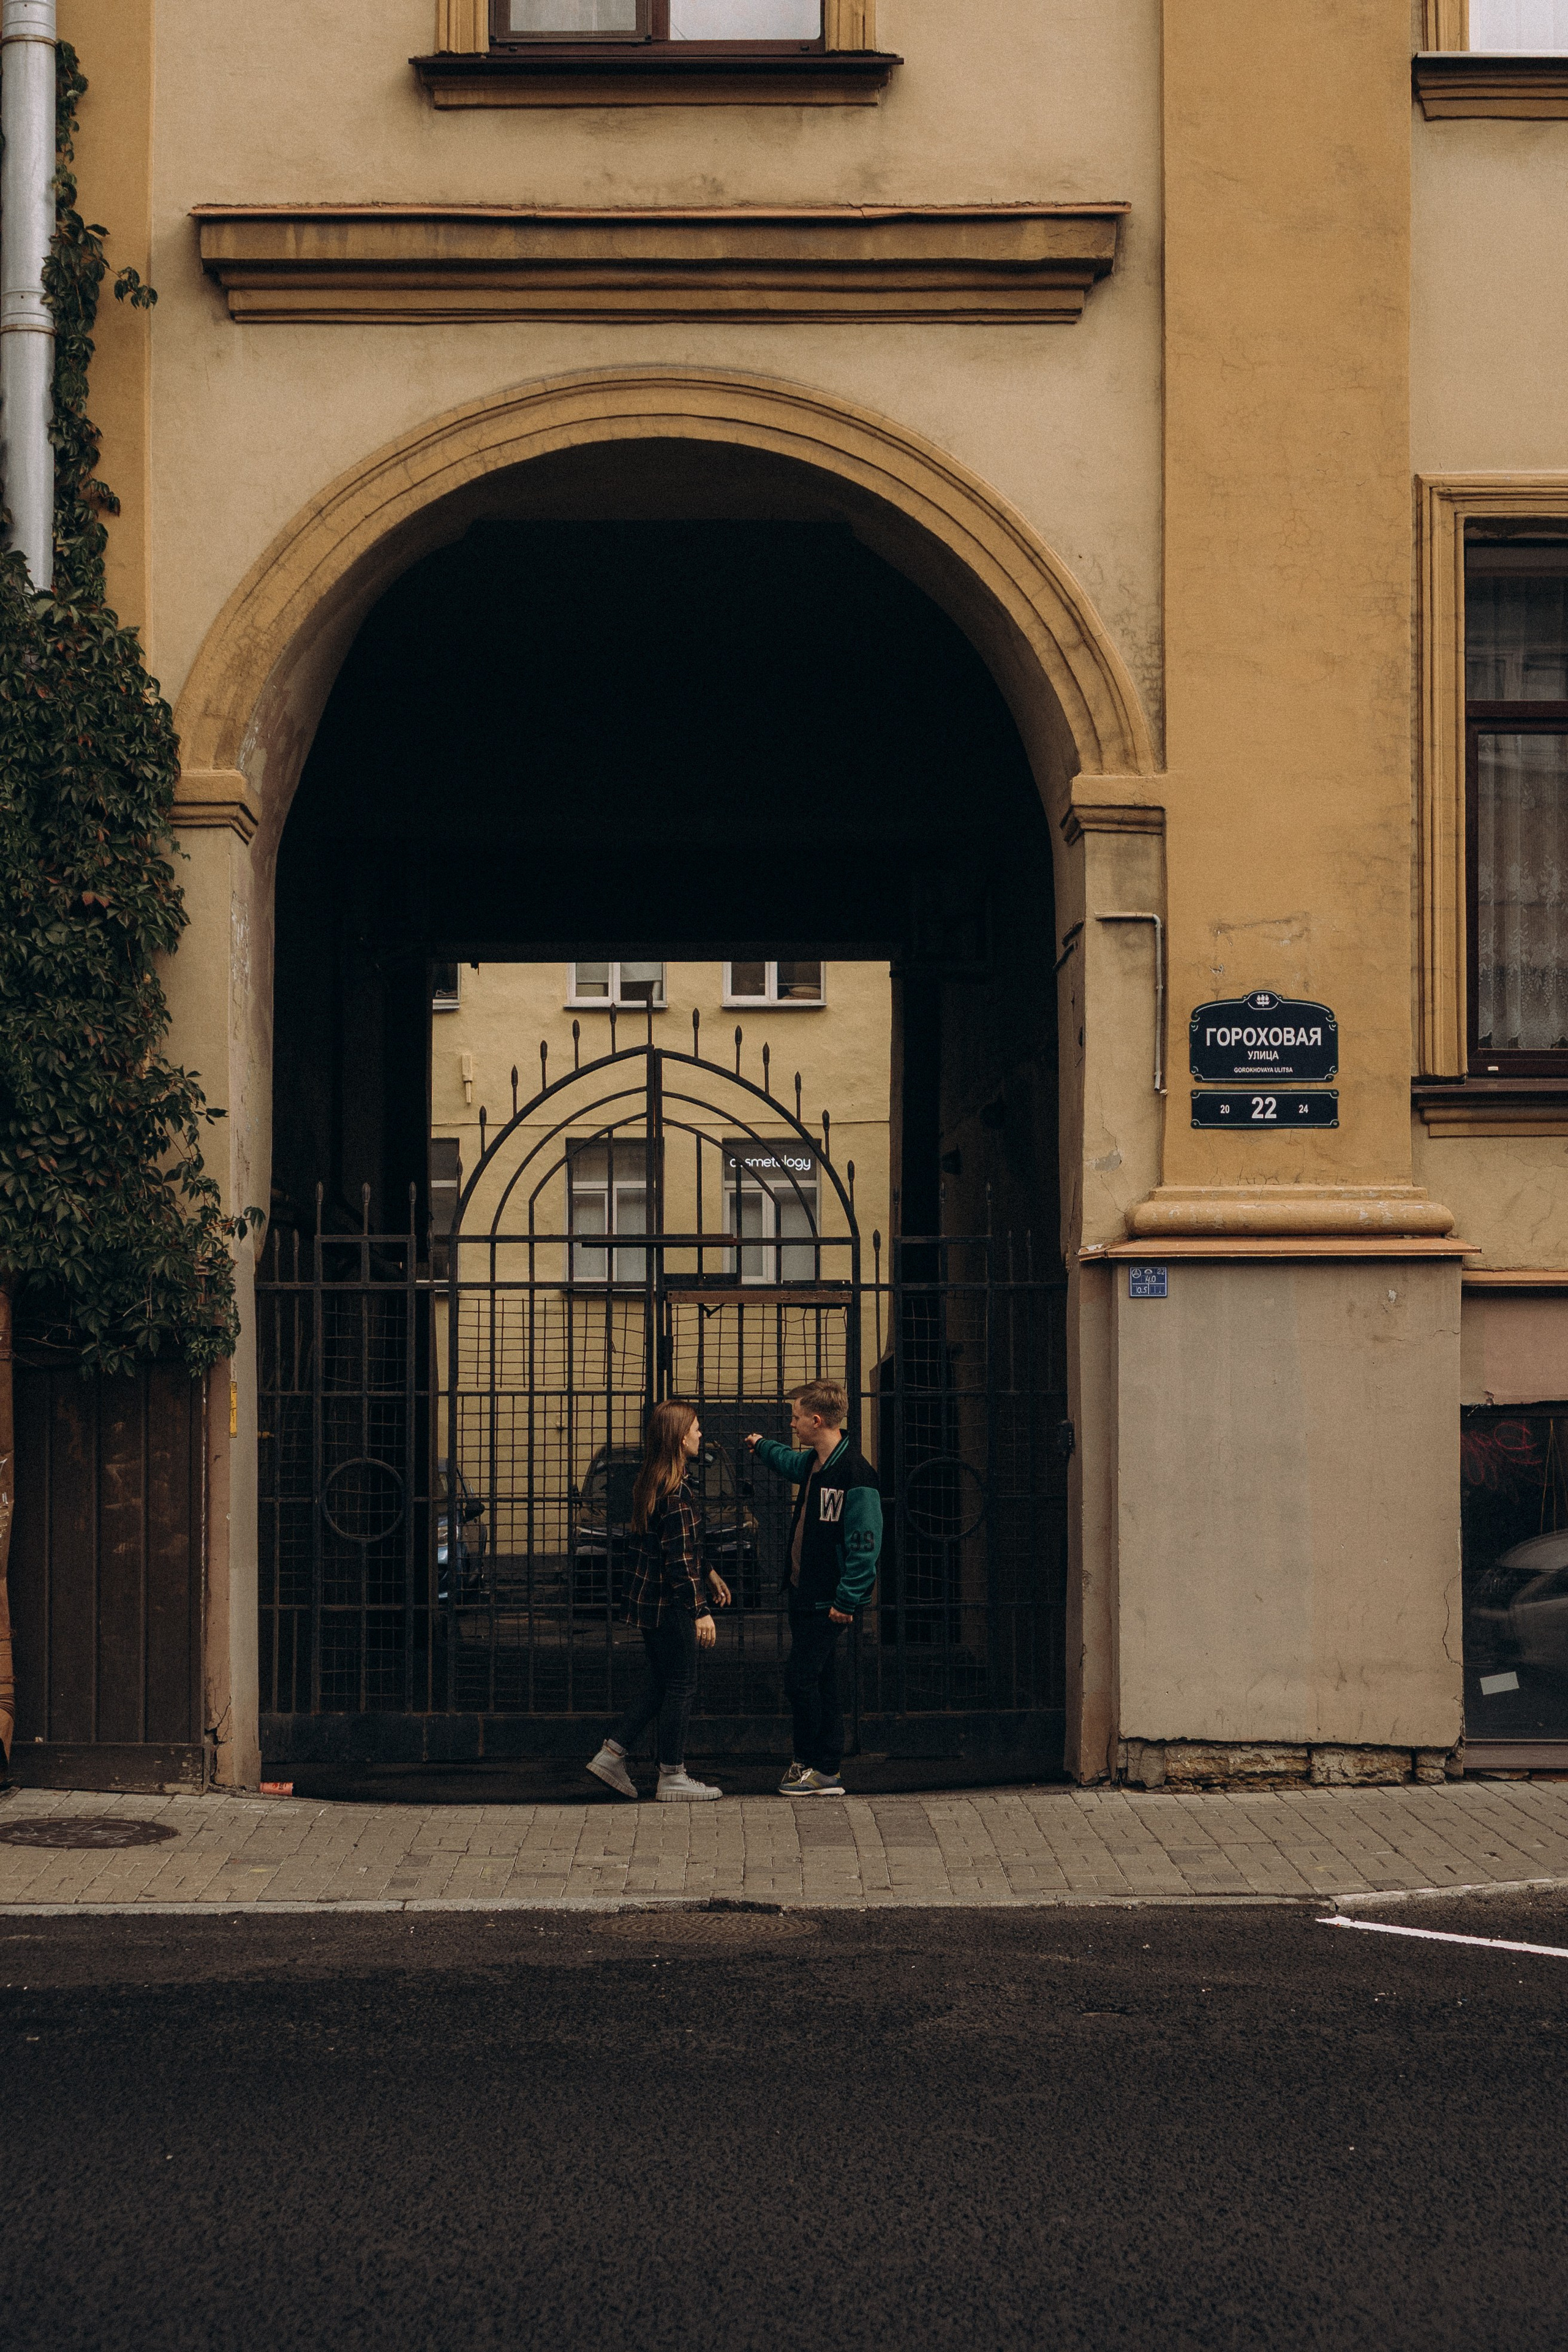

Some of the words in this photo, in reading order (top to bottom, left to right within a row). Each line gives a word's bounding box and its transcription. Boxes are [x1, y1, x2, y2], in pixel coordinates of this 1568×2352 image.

[1205, 1027, 1322, 1046] ГОРОХОВАЯ
[1247, 1050, 1279, 1061] УЛИЦА
[1220, 1104, 1230, 1114] 20
[1251, 1096, 1277, 1119] 22
[1298, 1104, 1308, 1114] 24
[729, 1155, 811, 1171] csmetlogy
[820, 1487, 844, 1522] W
